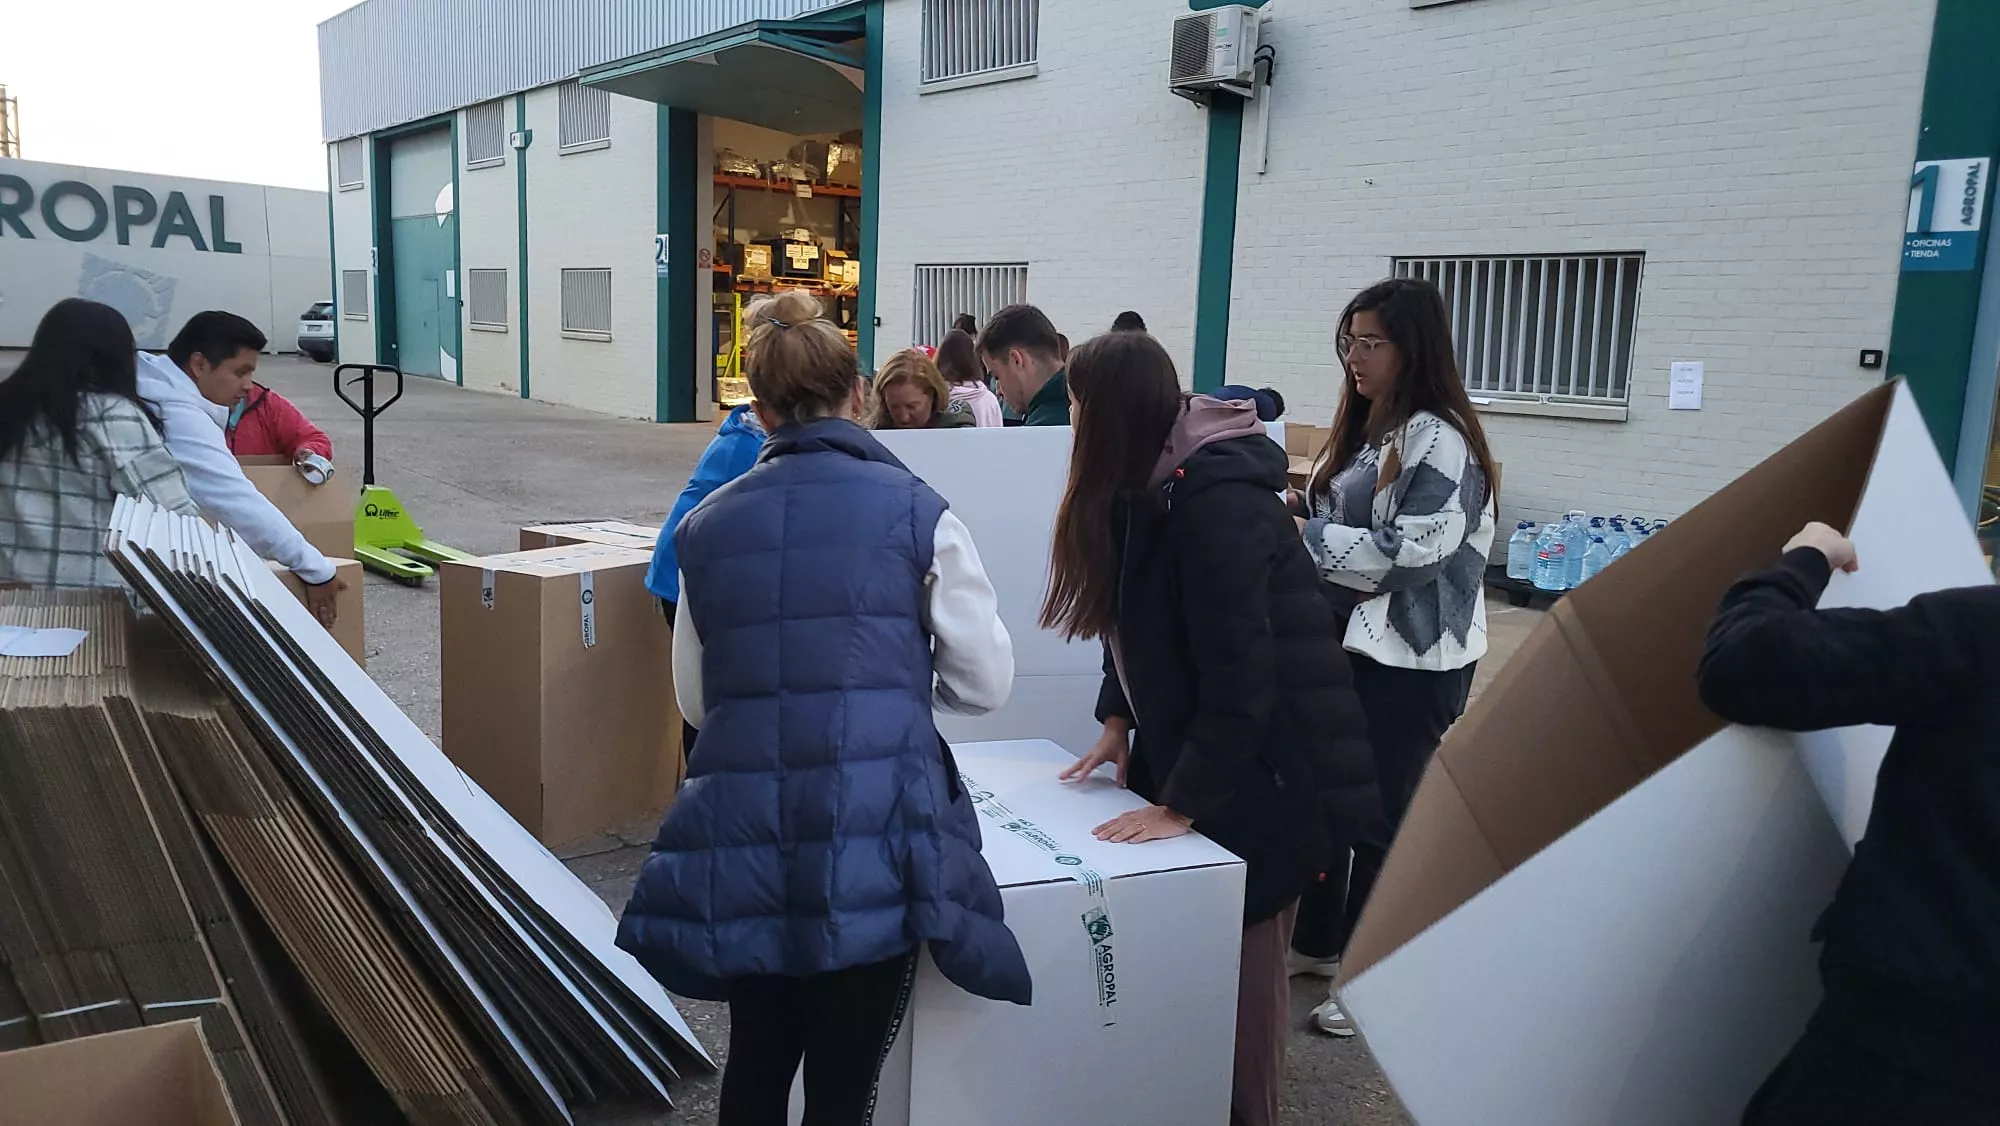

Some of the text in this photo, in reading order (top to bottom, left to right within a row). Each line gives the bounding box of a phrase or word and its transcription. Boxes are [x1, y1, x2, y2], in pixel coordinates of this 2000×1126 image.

[0, 174, 242, 254] ROPAL
[1911, 165, 1939, 233] 1
[1960, 162, 1980, 226] AGROPAL
[1912, 239, 1952, 248] OFICINAS
[1100, 944, 1117, 1007] AGROPAL
